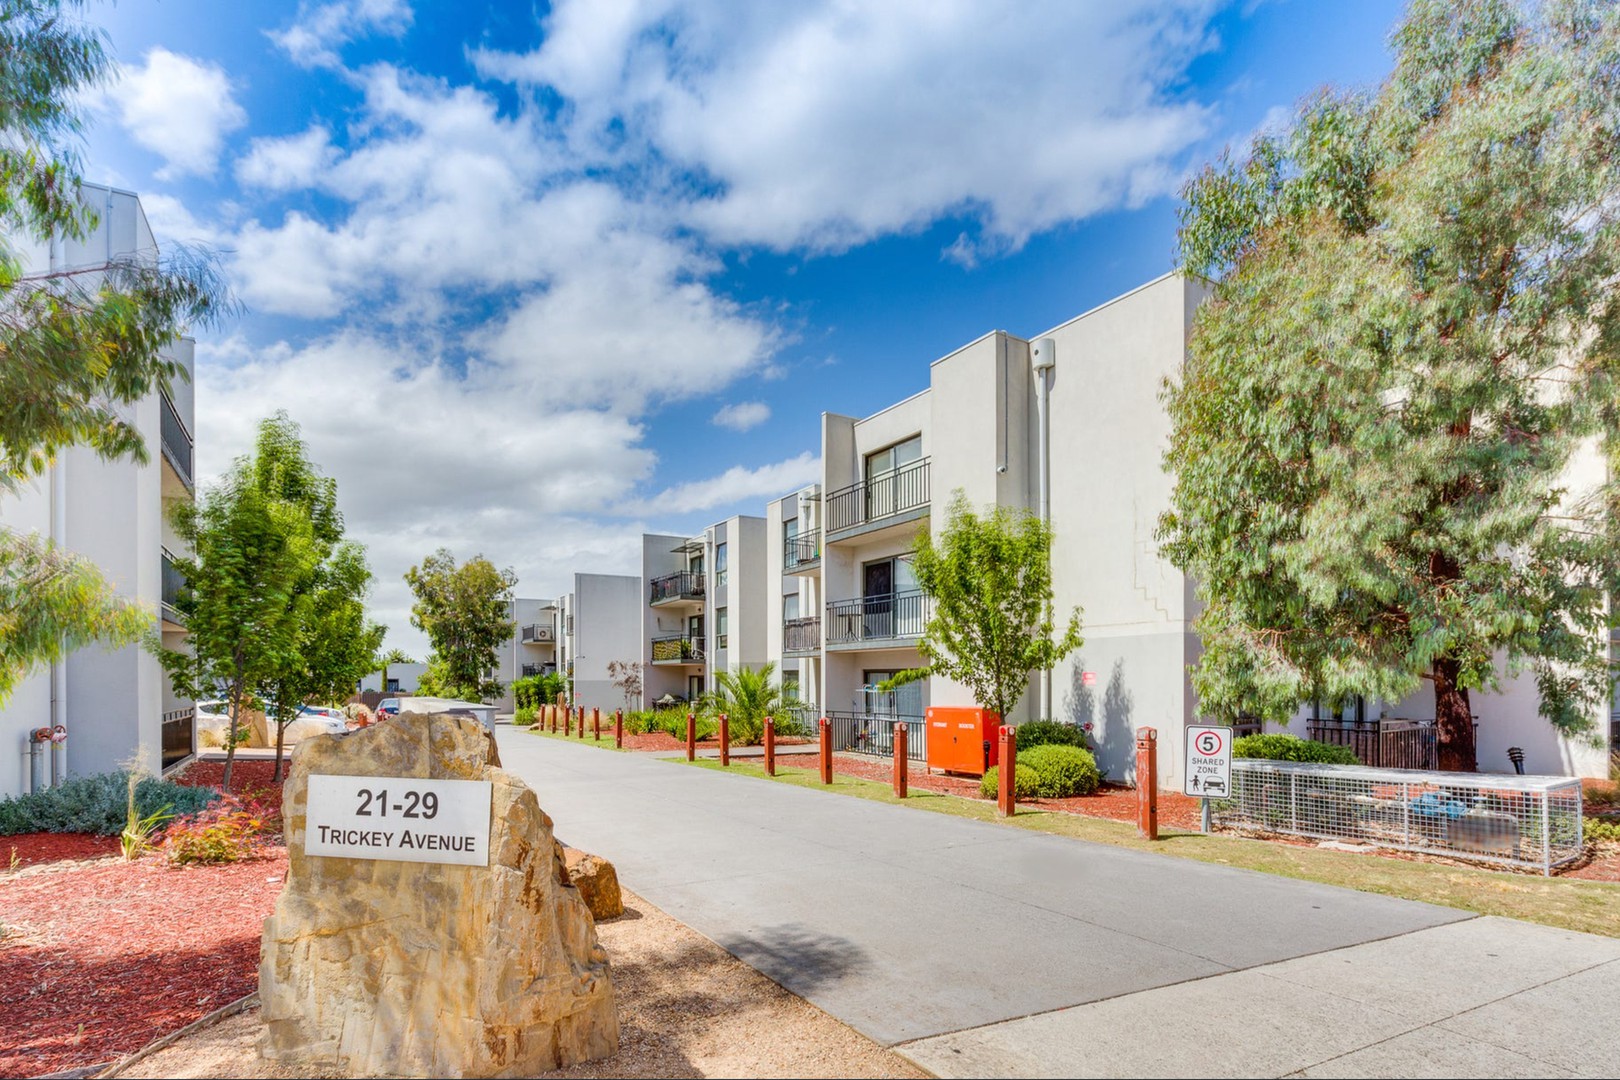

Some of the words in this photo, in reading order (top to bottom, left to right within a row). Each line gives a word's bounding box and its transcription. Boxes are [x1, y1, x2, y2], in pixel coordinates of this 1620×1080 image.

[1203, 736, 1214, 752] 5
[1191, 757, 1225, 766] SHARED
[1196, 766, 1219, 774] ZONE
[355, 788, 439, 820] 21-29
[317, 825, 394, 848] TRICKEY
[398, 829, 476, 852] AVENUE
